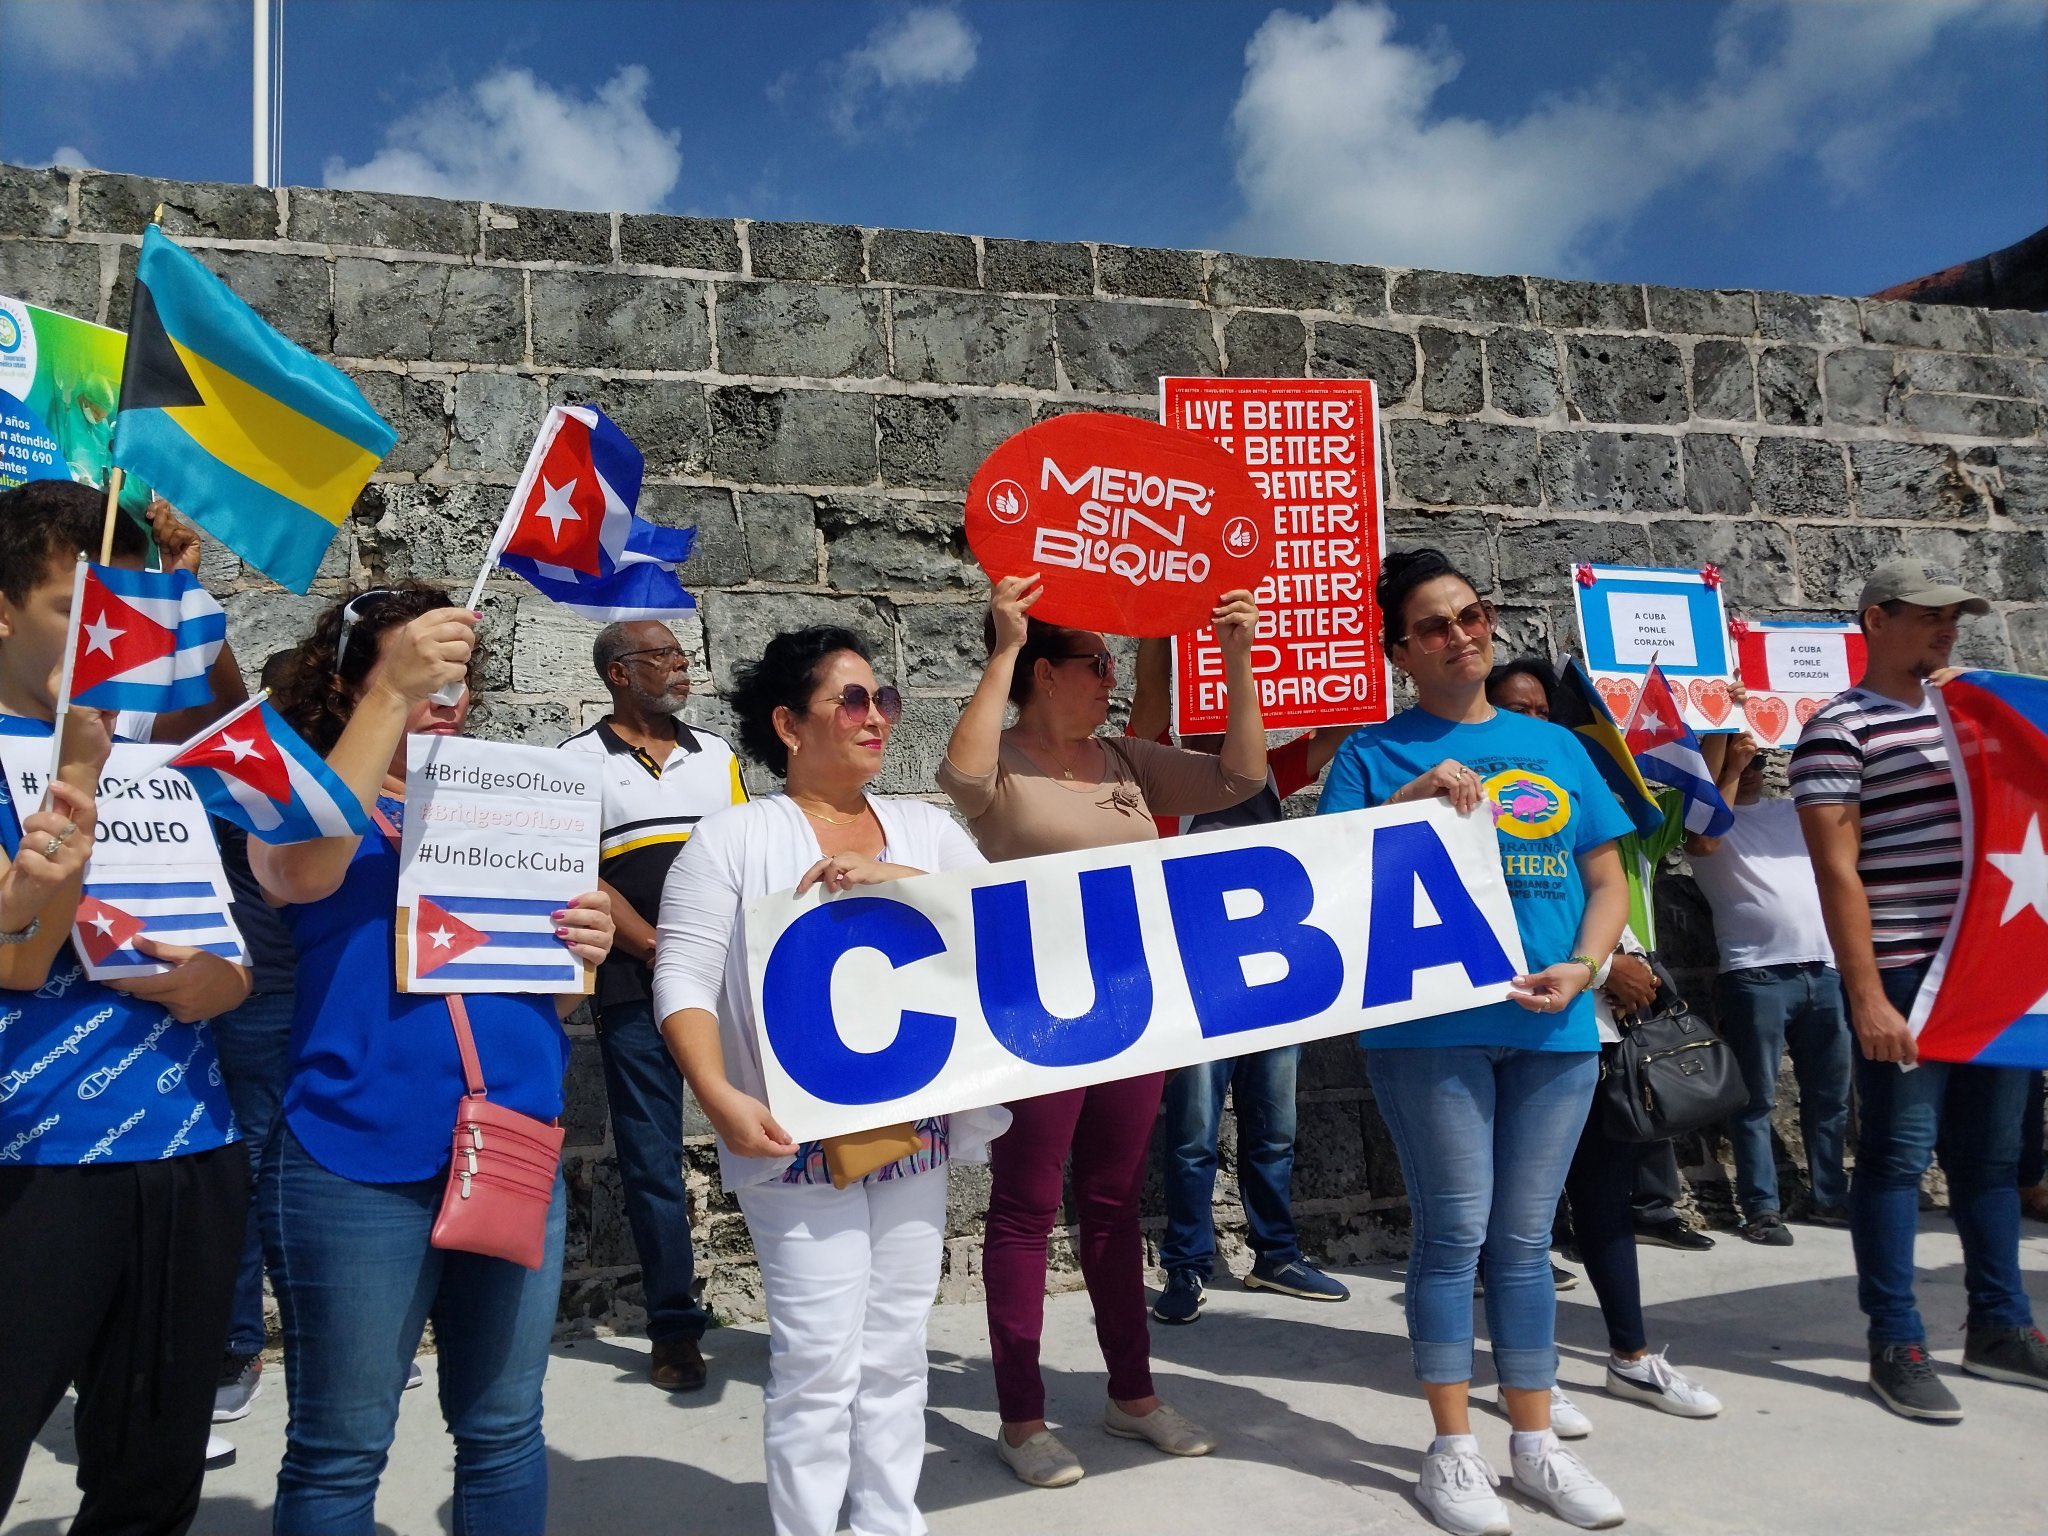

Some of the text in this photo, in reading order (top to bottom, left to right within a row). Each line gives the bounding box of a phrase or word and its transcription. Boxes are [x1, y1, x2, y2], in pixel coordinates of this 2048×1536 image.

[5, 416, 30, 430] años
[1185, 400, 1355, 430] LIVE BETTER
[8, 446, 29, 460] 430
[32, 450, 53, 465] 690
[10, 432, 57, 451] atendido
[1245, 436, 1356, 465] BETTER
[1040, 456, 1212, 516] MEJOR
[1077, 500, 1186, 547] SIN
[1274, 504, 1360, 534] ETTER
[1033, 526, 1211, 587] BLOQUEO
[1274, 539, 1361, 569] ETTER
[1254, 573, 1363, 605] BETTER
[1255, 607, 1364, 639] BETTER
[1638, 626, 1667, 634] PONLE
[1197, 640, 1366, 676] ED THE
[1199, 673, 1368, 711] EBARGO
[21, 771, 39, 795] #
[149, 778, 193, 802] SIN
[424, 762, 586, 796] #BridgesOfLove
[420, 802, 585, 832] #BridgesOfLove
[95, 820, 190, 848] OQUEO
[418, 843, 585, 874] #UnBlockCuba
[1504, 850, 1569, 878] HERS
[762, 819, 1517, 1107] CUBA
[77, 1013, 178, 1101] Champio
